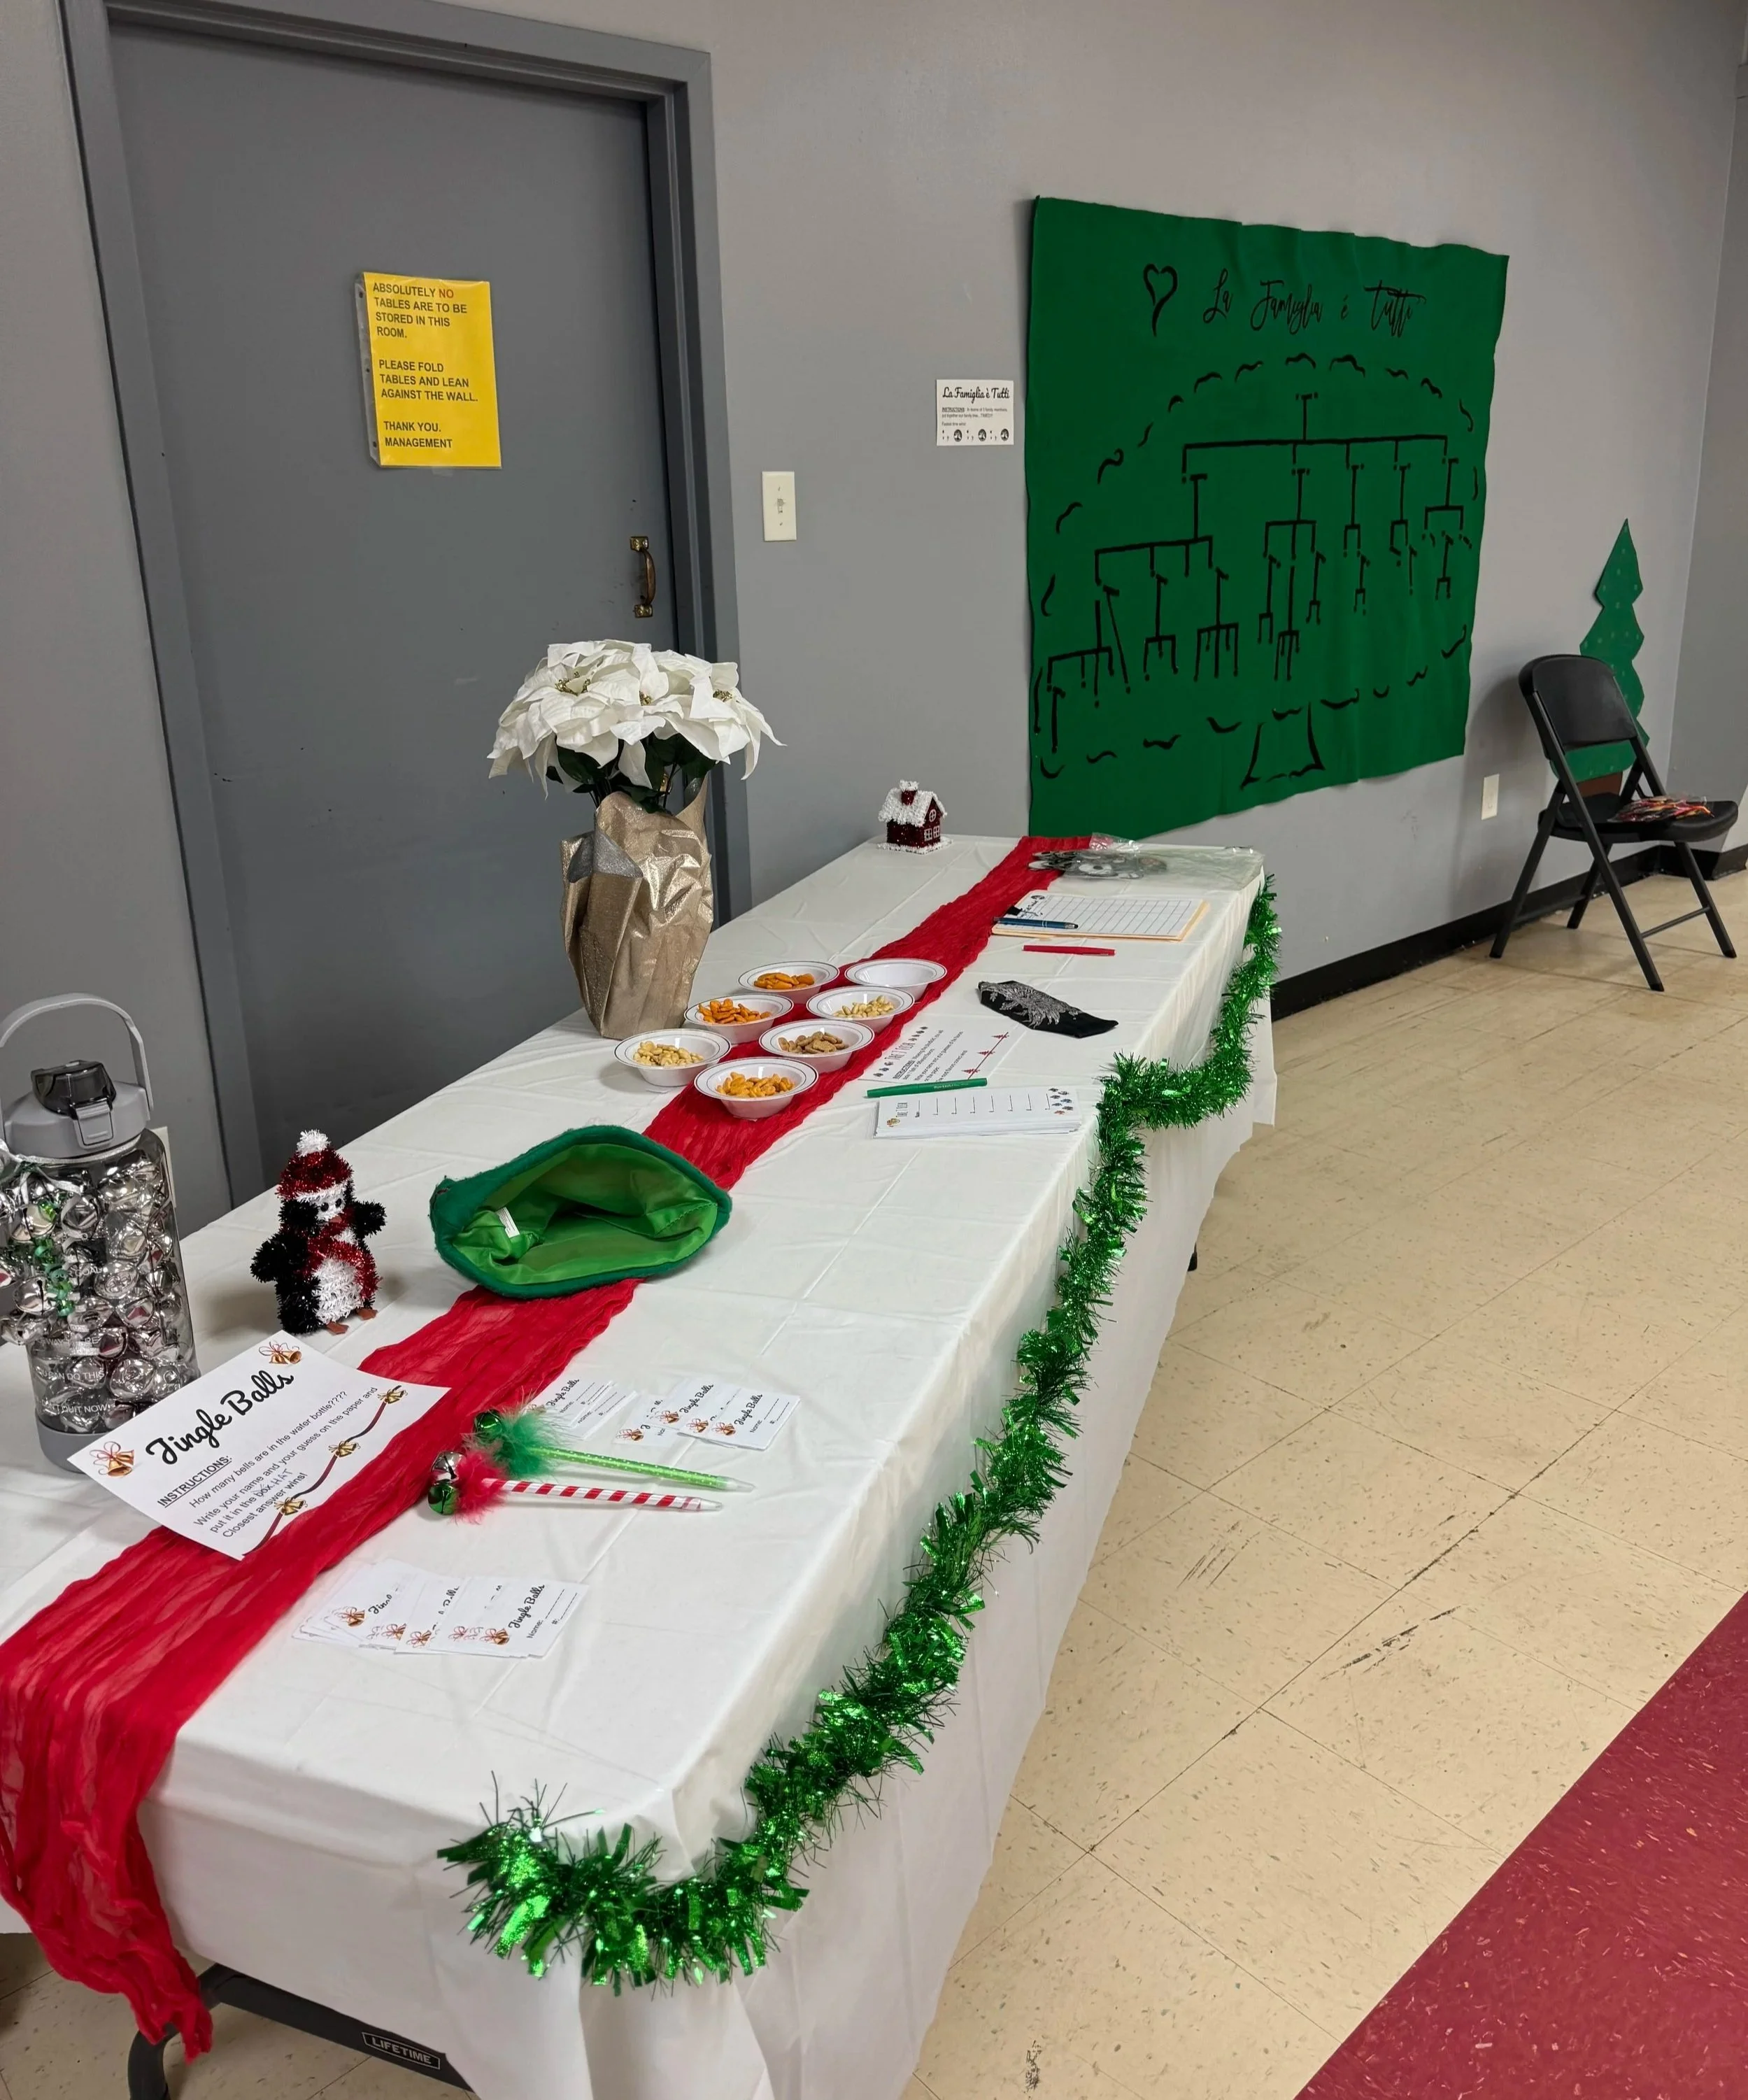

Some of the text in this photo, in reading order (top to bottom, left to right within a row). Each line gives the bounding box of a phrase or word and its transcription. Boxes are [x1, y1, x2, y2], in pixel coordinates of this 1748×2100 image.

[373, 283, 454, 299] ABSOLUTELY NO
[374, 297, 467, 313] TABLES ARE TO BE
[1202, 268, 1232, 324] La
[1250, 280, 1322, 335] Famiglia
[376, 312, 450, 327] STORED IN THIS
[377, 326, 407, 339] ROOM.
[379, 360, 443, 372] PLEASE FOLD
[380, 374, 469, 388] TABLES AND LEAN
[381, 388, 478, 402] AGAINST THE WALL.
[942, 387, 953, 398] La
[954, 386, 985, 404] Famiglia
[991, 388, 1010, 399] Tutti
[383, 420, 441, 432] THANK YOU.
[385, 437, 453, 448] MANAGEMENT
[83, 1370, 105, 1379] THIS
[679, 1398, 700, 1414] Jingle
[695, 1384, 714, 1398] Balls
[145, 1370, 294, 1465] Jingle Balls
[734, 1393, 763, 1426] Jingle Balls
[189, 1391, 348, 1508] How many bells are in the water bottle????
[194, 1387, 378, 1526] Write your name and your guess on the paper and
[157, 1455, 232, 1507] INSTRUCTIONS:
[271, 1468, 293, 1485] HAT
[222, 1472, 308, 1538] Closest answer wins!
[210, 1520, 227, 1533] put
[232, 1507, 243, 1516] in
[240, 1496, 257, 1508] the
[508, 1584, 545, 1629] Jingle Balls
[372, 2036, 432, 2064] LIFETIME
